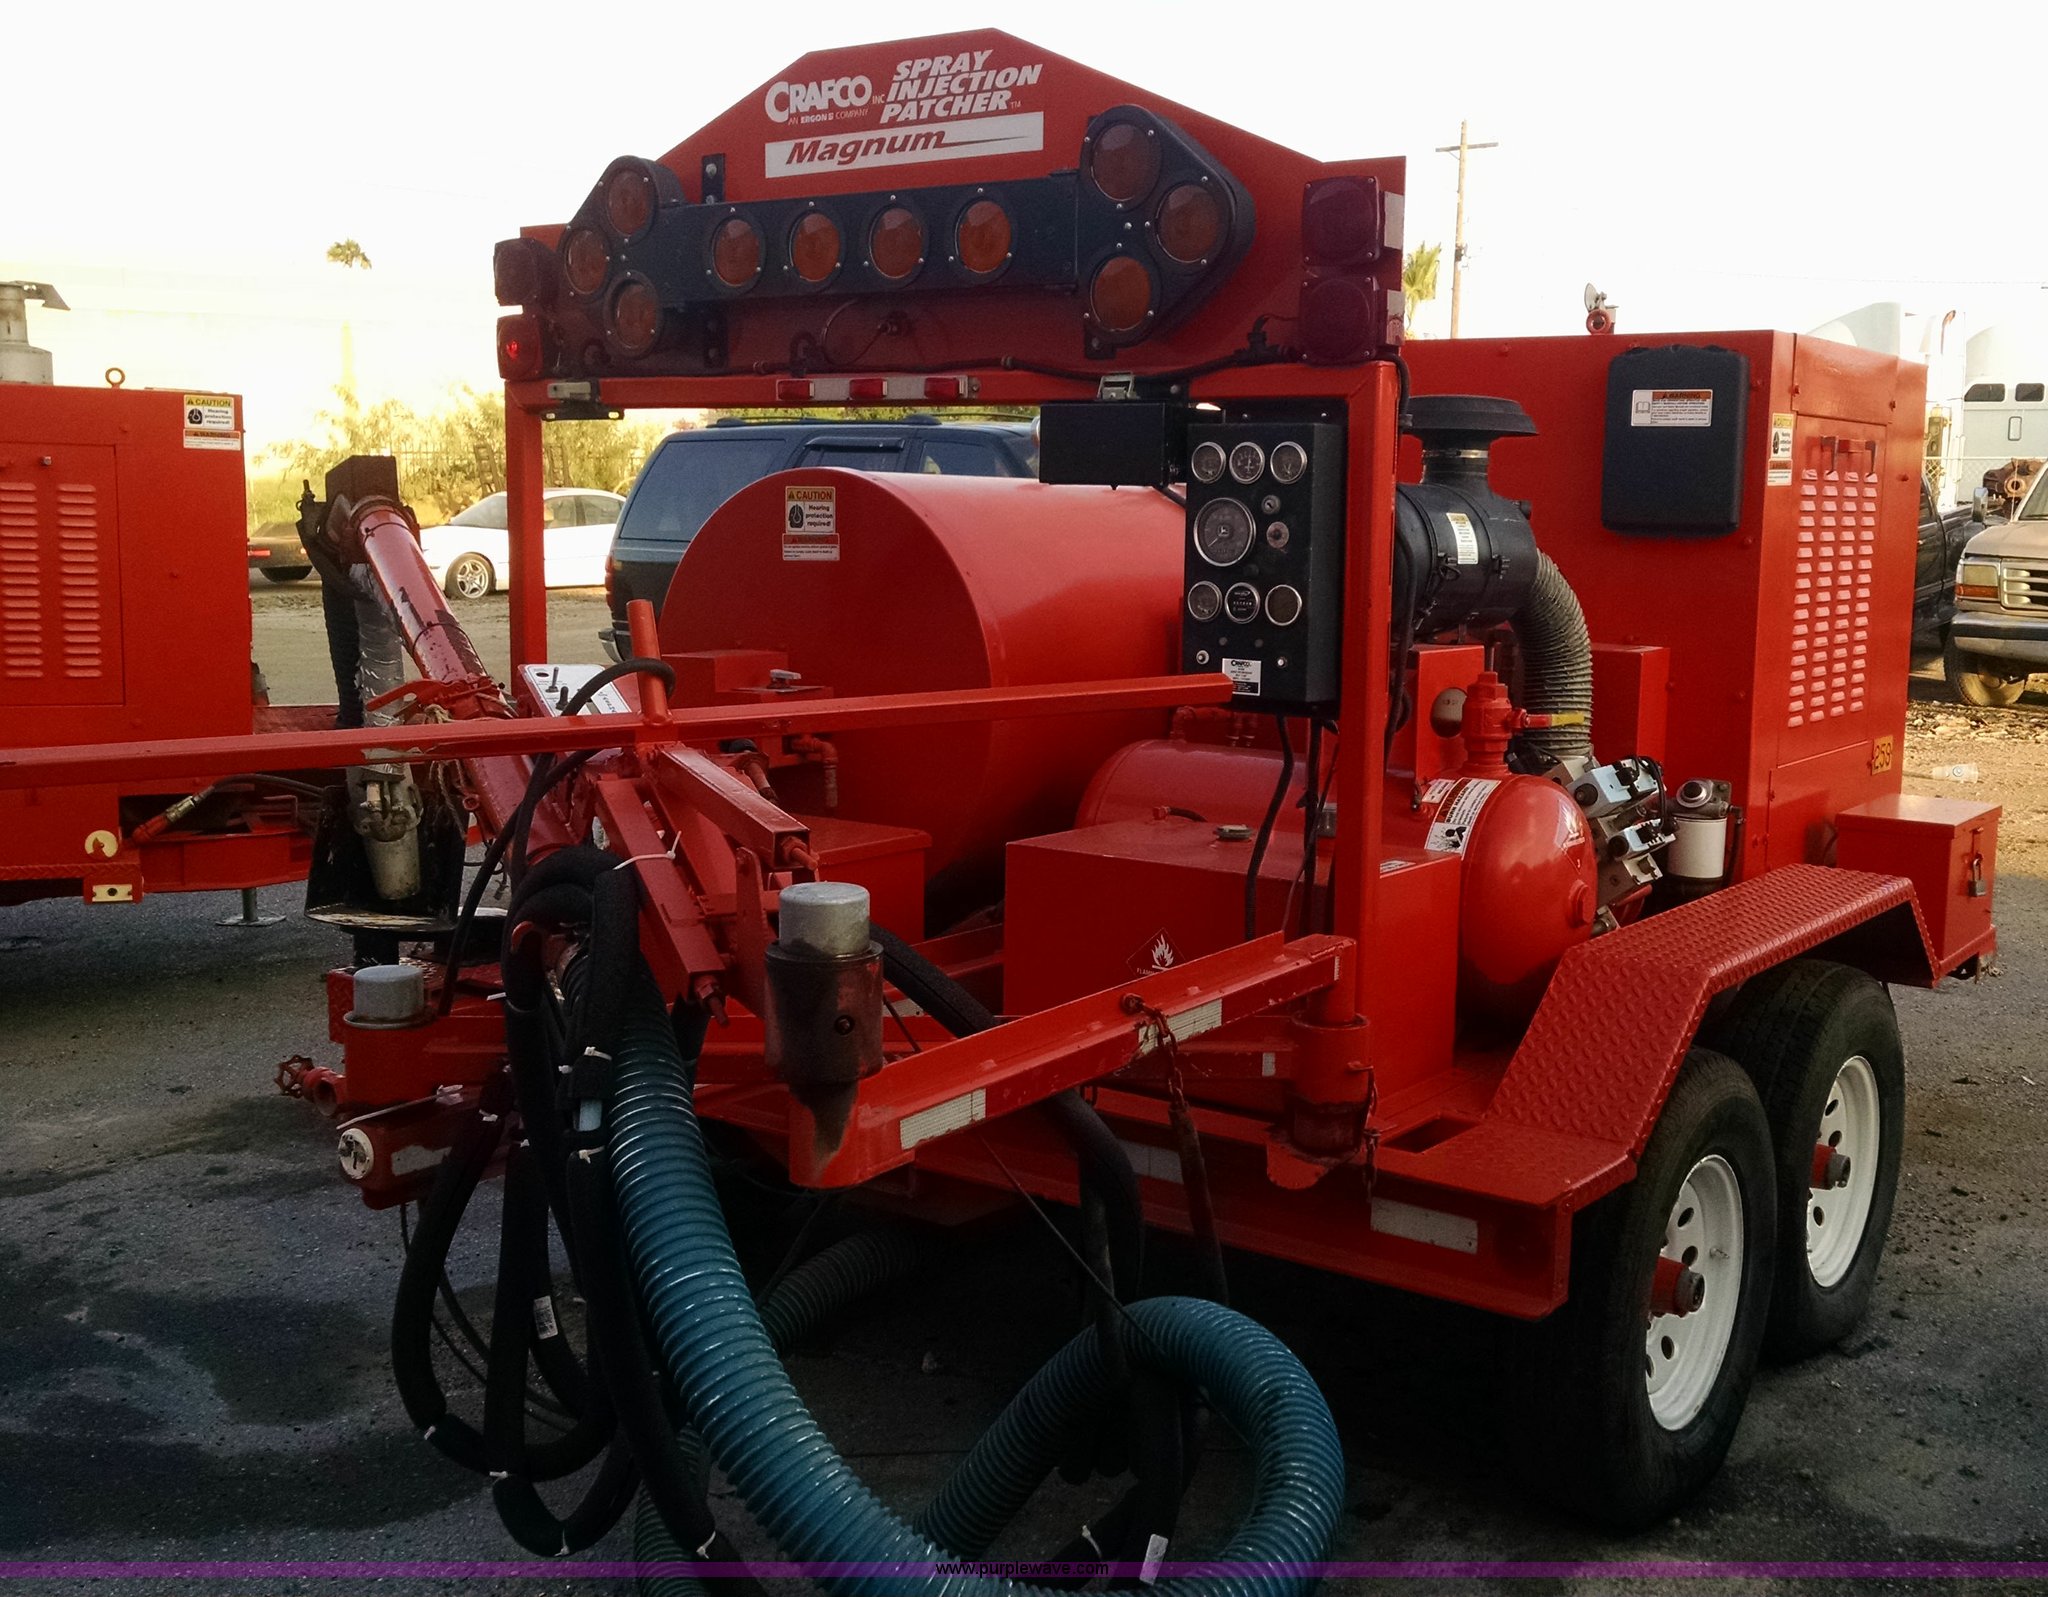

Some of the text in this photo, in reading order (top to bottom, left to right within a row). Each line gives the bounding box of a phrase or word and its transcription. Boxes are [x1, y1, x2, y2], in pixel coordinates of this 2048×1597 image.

[893, 49, 993, 81] SPRAY
[765, 75, 872, 123] CRAFCO
[887, 64, 1043, 102] INJECTION
[835, 108, 869, 120] COMPANY
[880, 90, 1012, 124] PATCHER
[785, 128, 950, 166] Magnum
[195, 399, 231, 407] CAUTION
[796, 491, 832, 500] CAUTION
